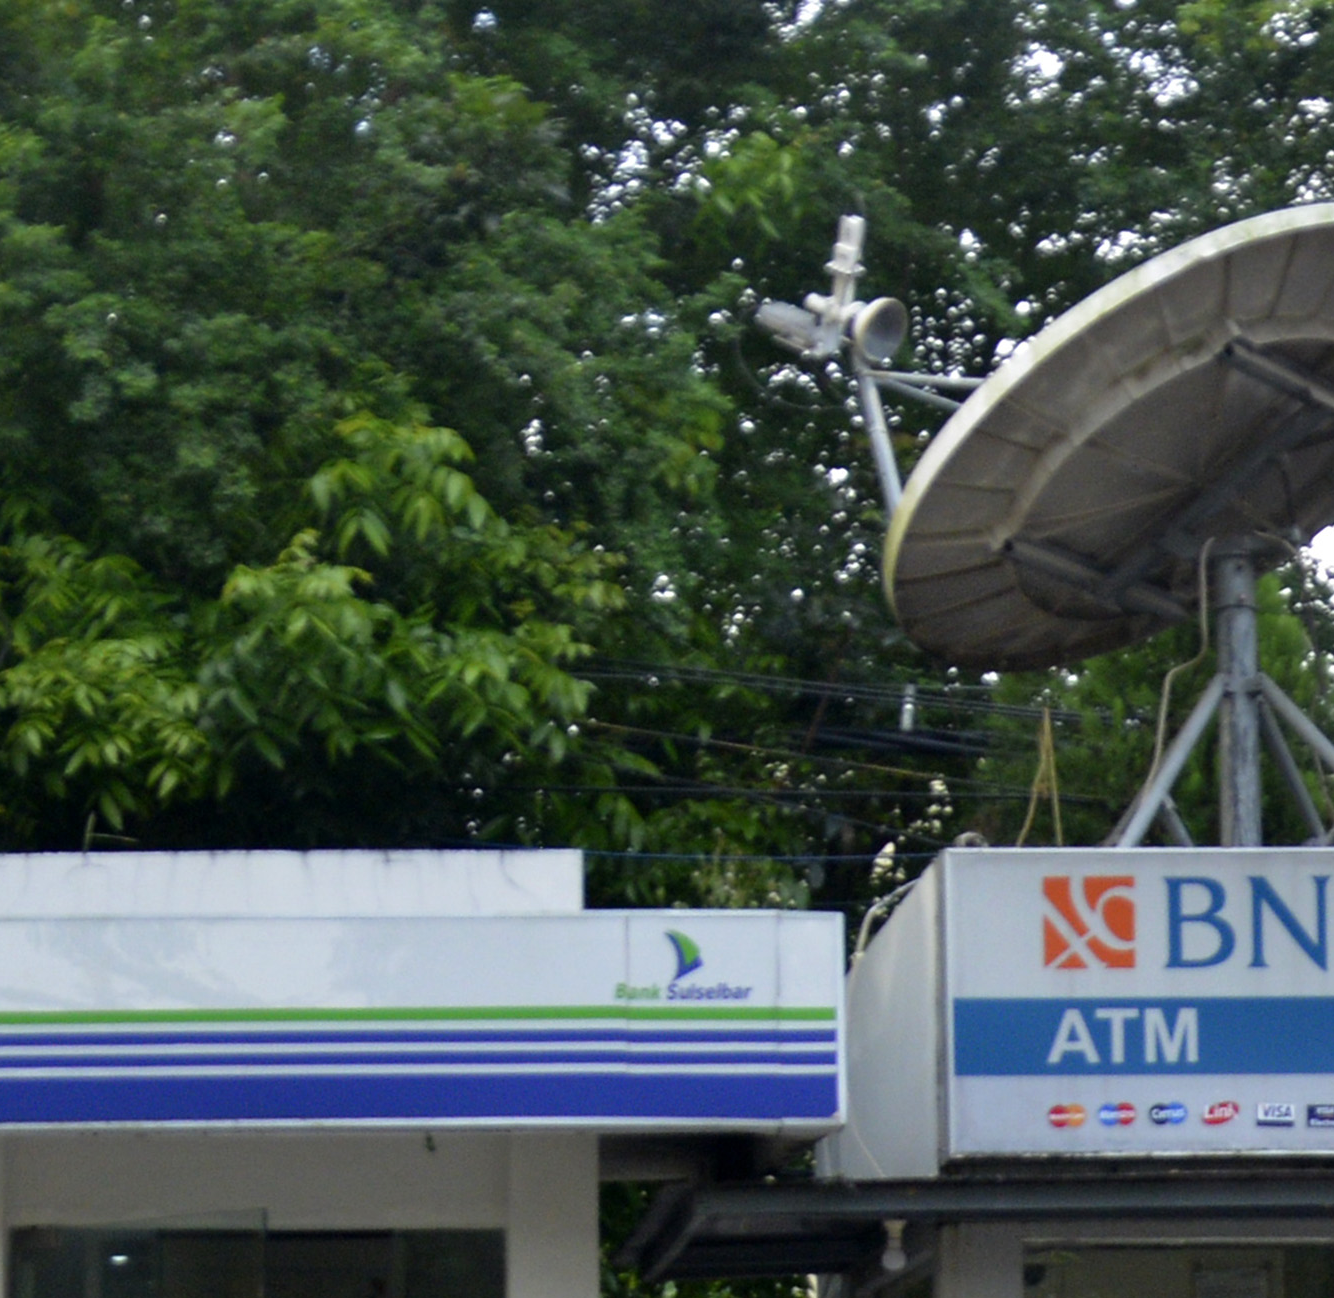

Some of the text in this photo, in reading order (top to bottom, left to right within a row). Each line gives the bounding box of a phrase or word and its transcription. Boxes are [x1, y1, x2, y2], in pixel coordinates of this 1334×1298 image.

[615, 983, 752, 1000] Bank Sulselbar
[1046, 1007, 1199, 1063] ATM
[1263, 1105, 1292, 1117] VISA
